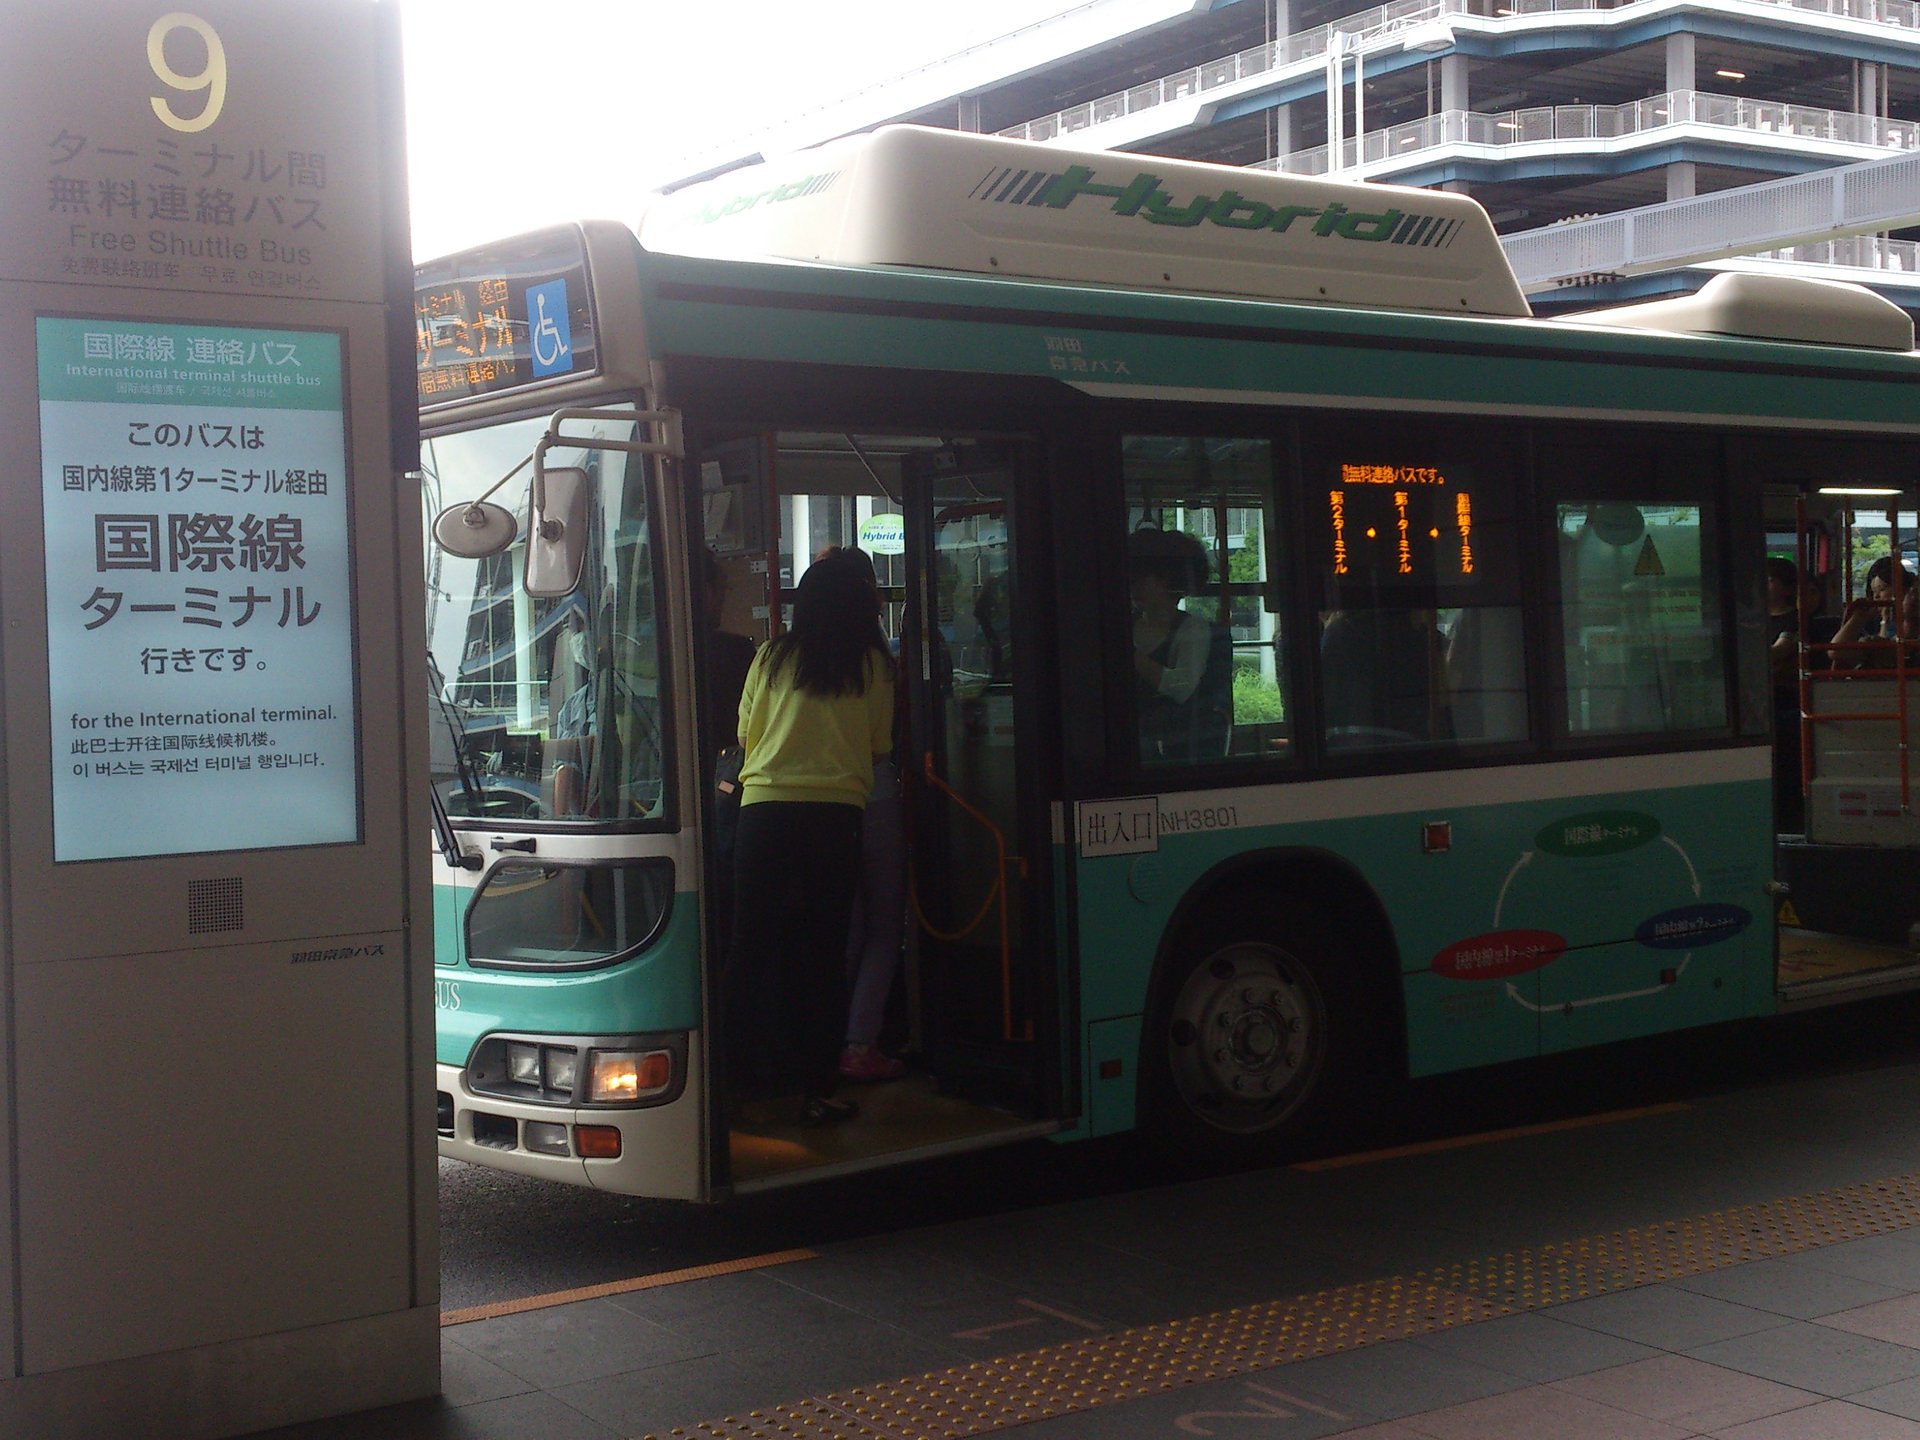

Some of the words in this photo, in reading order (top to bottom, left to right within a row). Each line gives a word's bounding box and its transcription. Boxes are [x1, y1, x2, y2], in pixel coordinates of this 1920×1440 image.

[147, 12, 227, 133] 9
[48, 129, 327, 190] ターミナル間
[47, 174, 327, 231] 無料連絡バス
[1043, 165, 1404, 242] Hybrid
[70, 224, 136, 252] Free
[149, 230, 248, 260] Shuttle
[261, 239, 312, 266] Bus
[83, 332, 175, 361] 国際線
[186, 337, 301, 367] 連絡バス
[66, 363, 167, 380] International
[172, 367, 236, 383] terminal
[240, 371, 291, 385] shuttle
[296, 374, 321, 386] bus
[128, 422, 265, 450] このバスは
[62, 465, 328, 496] 国内線第1ターミナル経由
[94, 513, 307, 573] 国際線
[863, 532, 897, 542] Hybrid
[1329, 490, 1348, 574] 第2ターミナル
[1393, 490, 1413, 574] 第1ターミナル
[80, 586, 321, 631] ターミナル
[141, 646, 266, 675] 行きです。
[70, 713, 98, 729] for
[104, 712, 134, 728] the
[140, 708, 255, 727] International
[261, 704, 337, 723] terminal.
[70, 730, 276, 755] 此巴士开往国际线候机楼。
[72, 762, 89, 778] 이
[95, 760, 145, 776] 버스는
[150, 758, 199, 774] 국제선
[205, 755, 251, 772] 터미널
[257, 752, 325, 769] 행입니다.
[1088, 811, 1151, 847] 出入口
[1160, 806, 1238, 832] NH3801
